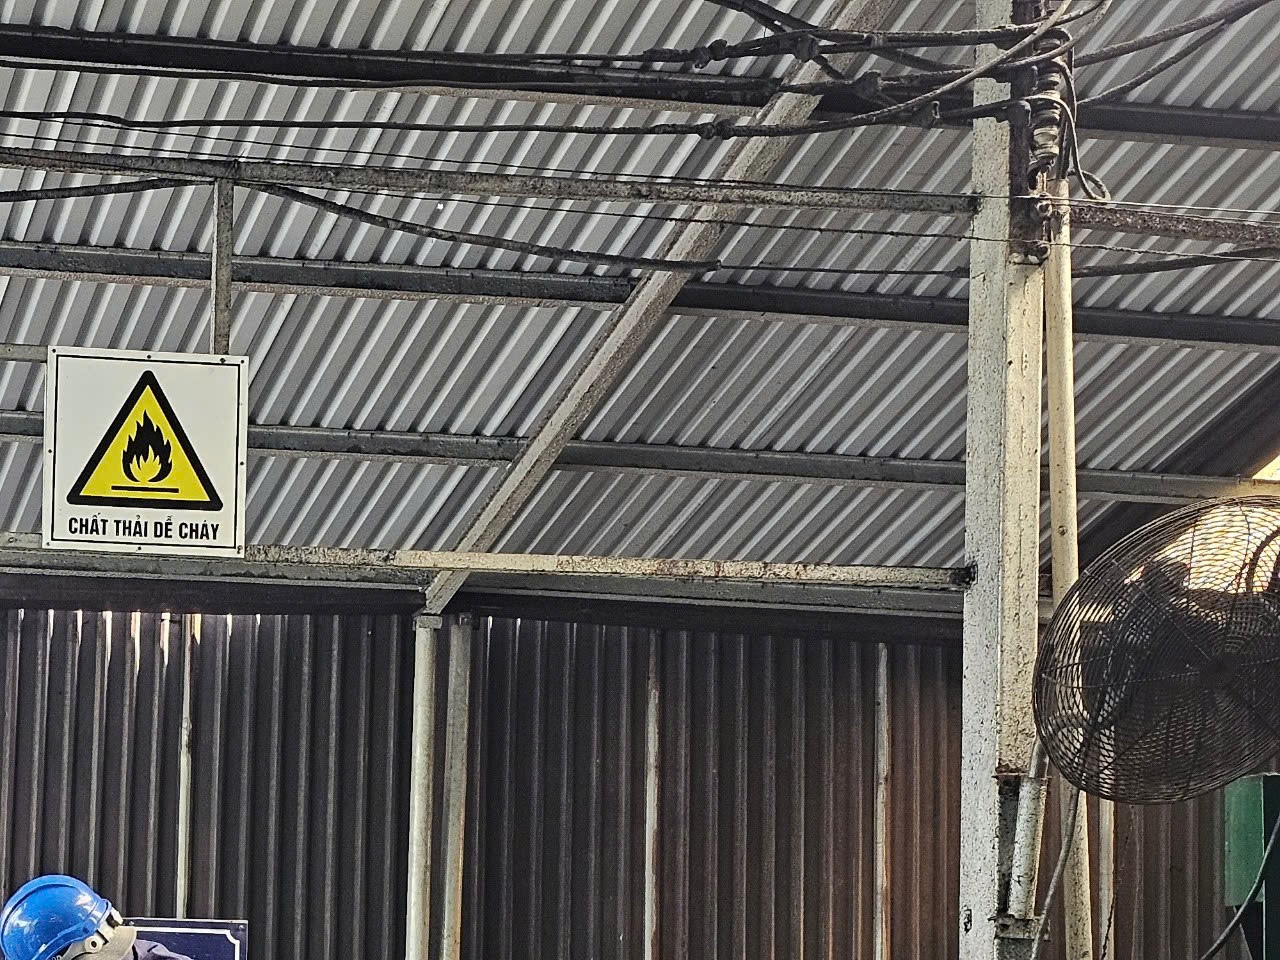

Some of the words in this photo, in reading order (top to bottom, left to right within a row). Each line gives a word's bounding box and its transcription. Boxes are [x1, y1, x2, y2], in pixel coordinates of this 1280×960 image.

[68, 513, 109, 535] CHẤT
[115, 516, 148, 537] THẢI
[153, 519, 174, 539] DỄ
